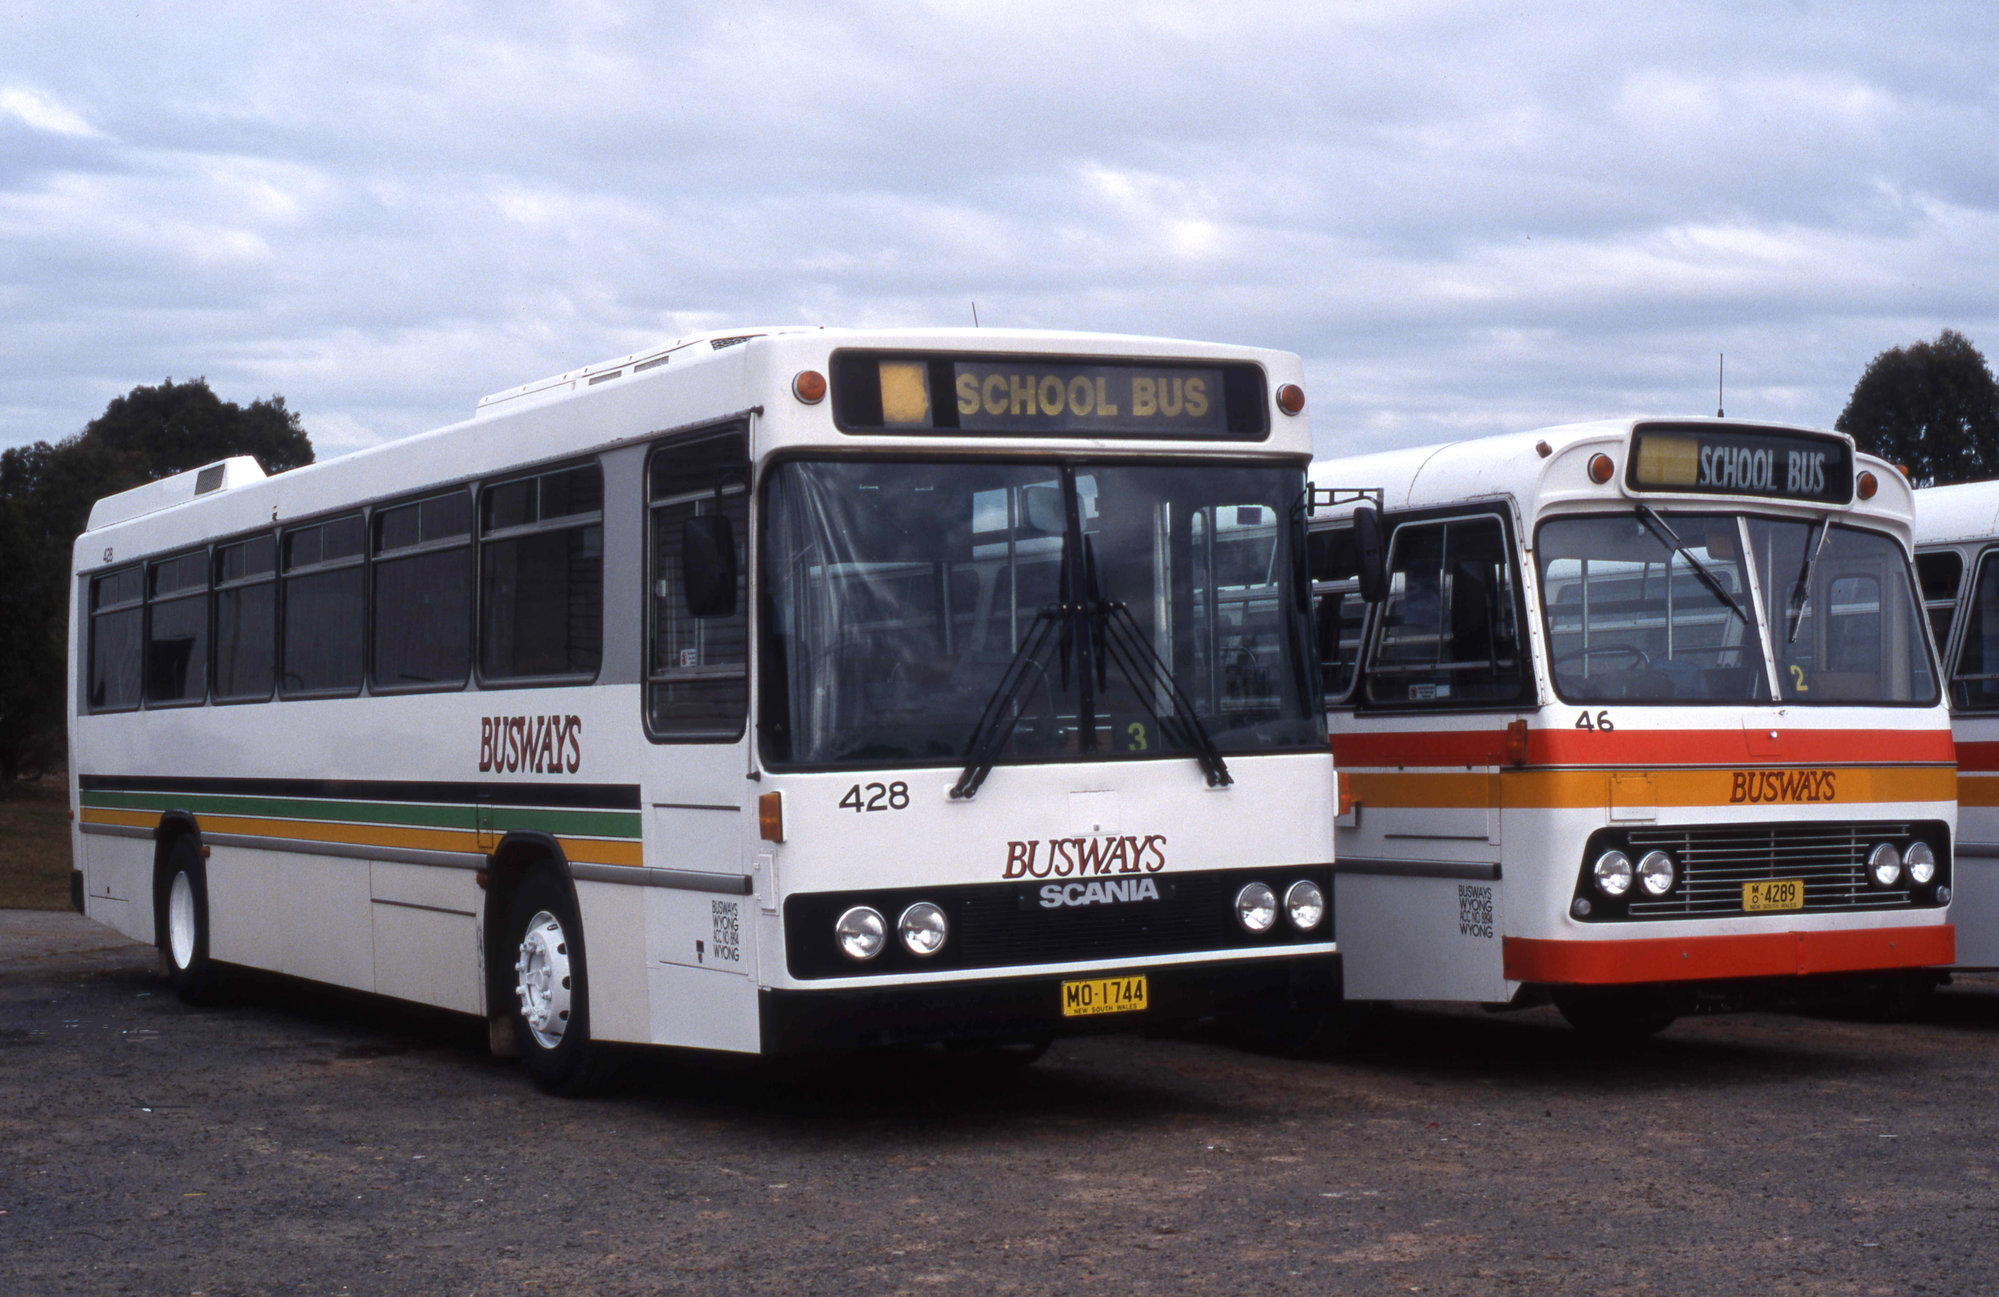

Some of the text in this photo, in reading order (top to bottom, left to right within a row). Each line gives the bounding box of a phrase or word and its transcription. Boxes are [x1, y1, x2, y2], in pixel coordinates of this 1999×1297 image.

[955, 373, 1209, 417] SCHOOL BUS
[1700, 445, 1825, 494] SCHOOL BUS
[1790, 665, 1808, 691] 2
[1575, 710, 1614, 733] 46
[479, 715, 581, 774] BUSWAYS
[1127, 722, 1147, 750] 3
[838, 780, 910, 813] 428
[1729, 771, 1836, 803] BUSWAYS
[1002, 834, 1167, 879] BUSWAYS
[1039, 878, 1160, 908] SCANIA
[1459, 884, 1492, 900] BUSWAYS
[1459, 898, 1493, 912] WYONG
[712, 900, 738, 917] BUSWAYS
[713, 914, 739, 932] WYONG
[1460, 923, 1493, 938] WYONG
[713, 944, 740, 962] WYONG
[1091, 1004, 1113, 1012] SOUTH
[1117, 1002, 1137, 1010] WALES
